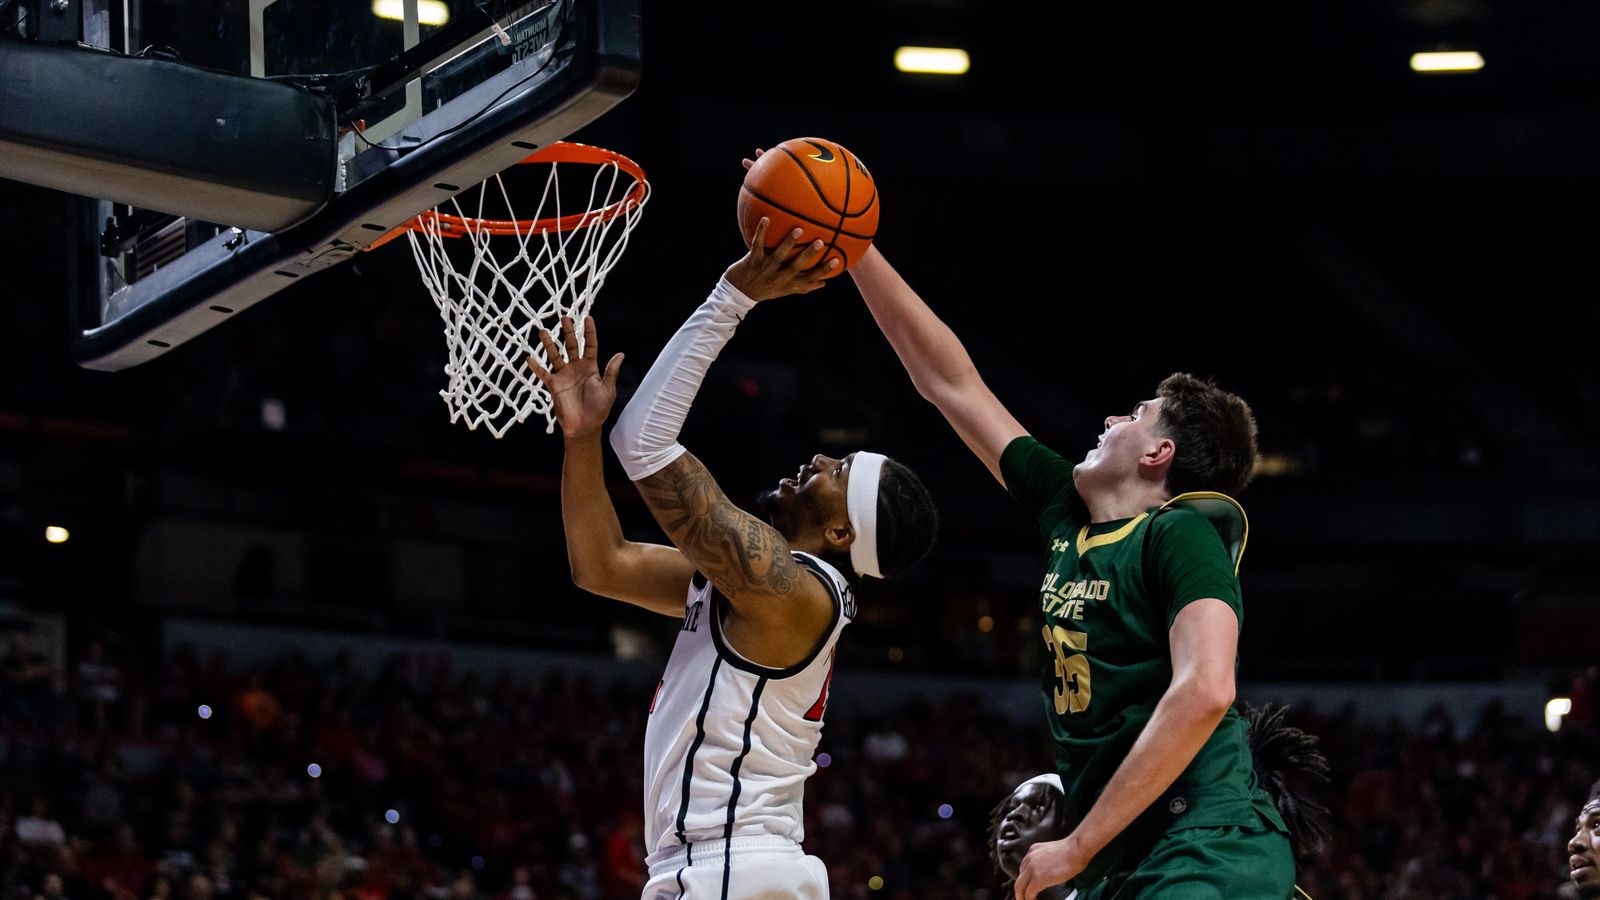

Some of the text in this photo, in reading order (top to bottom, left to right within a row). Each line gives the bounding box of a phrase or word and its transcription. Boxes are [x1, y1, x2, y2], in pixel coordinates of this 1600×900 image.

[747, 519, 762, 562] VEGAS
[1040, 573, 1110, 601] OLOADO
[1042, 593, 1085, 620] STATE
[1042, 624, 1092, 714] 35
